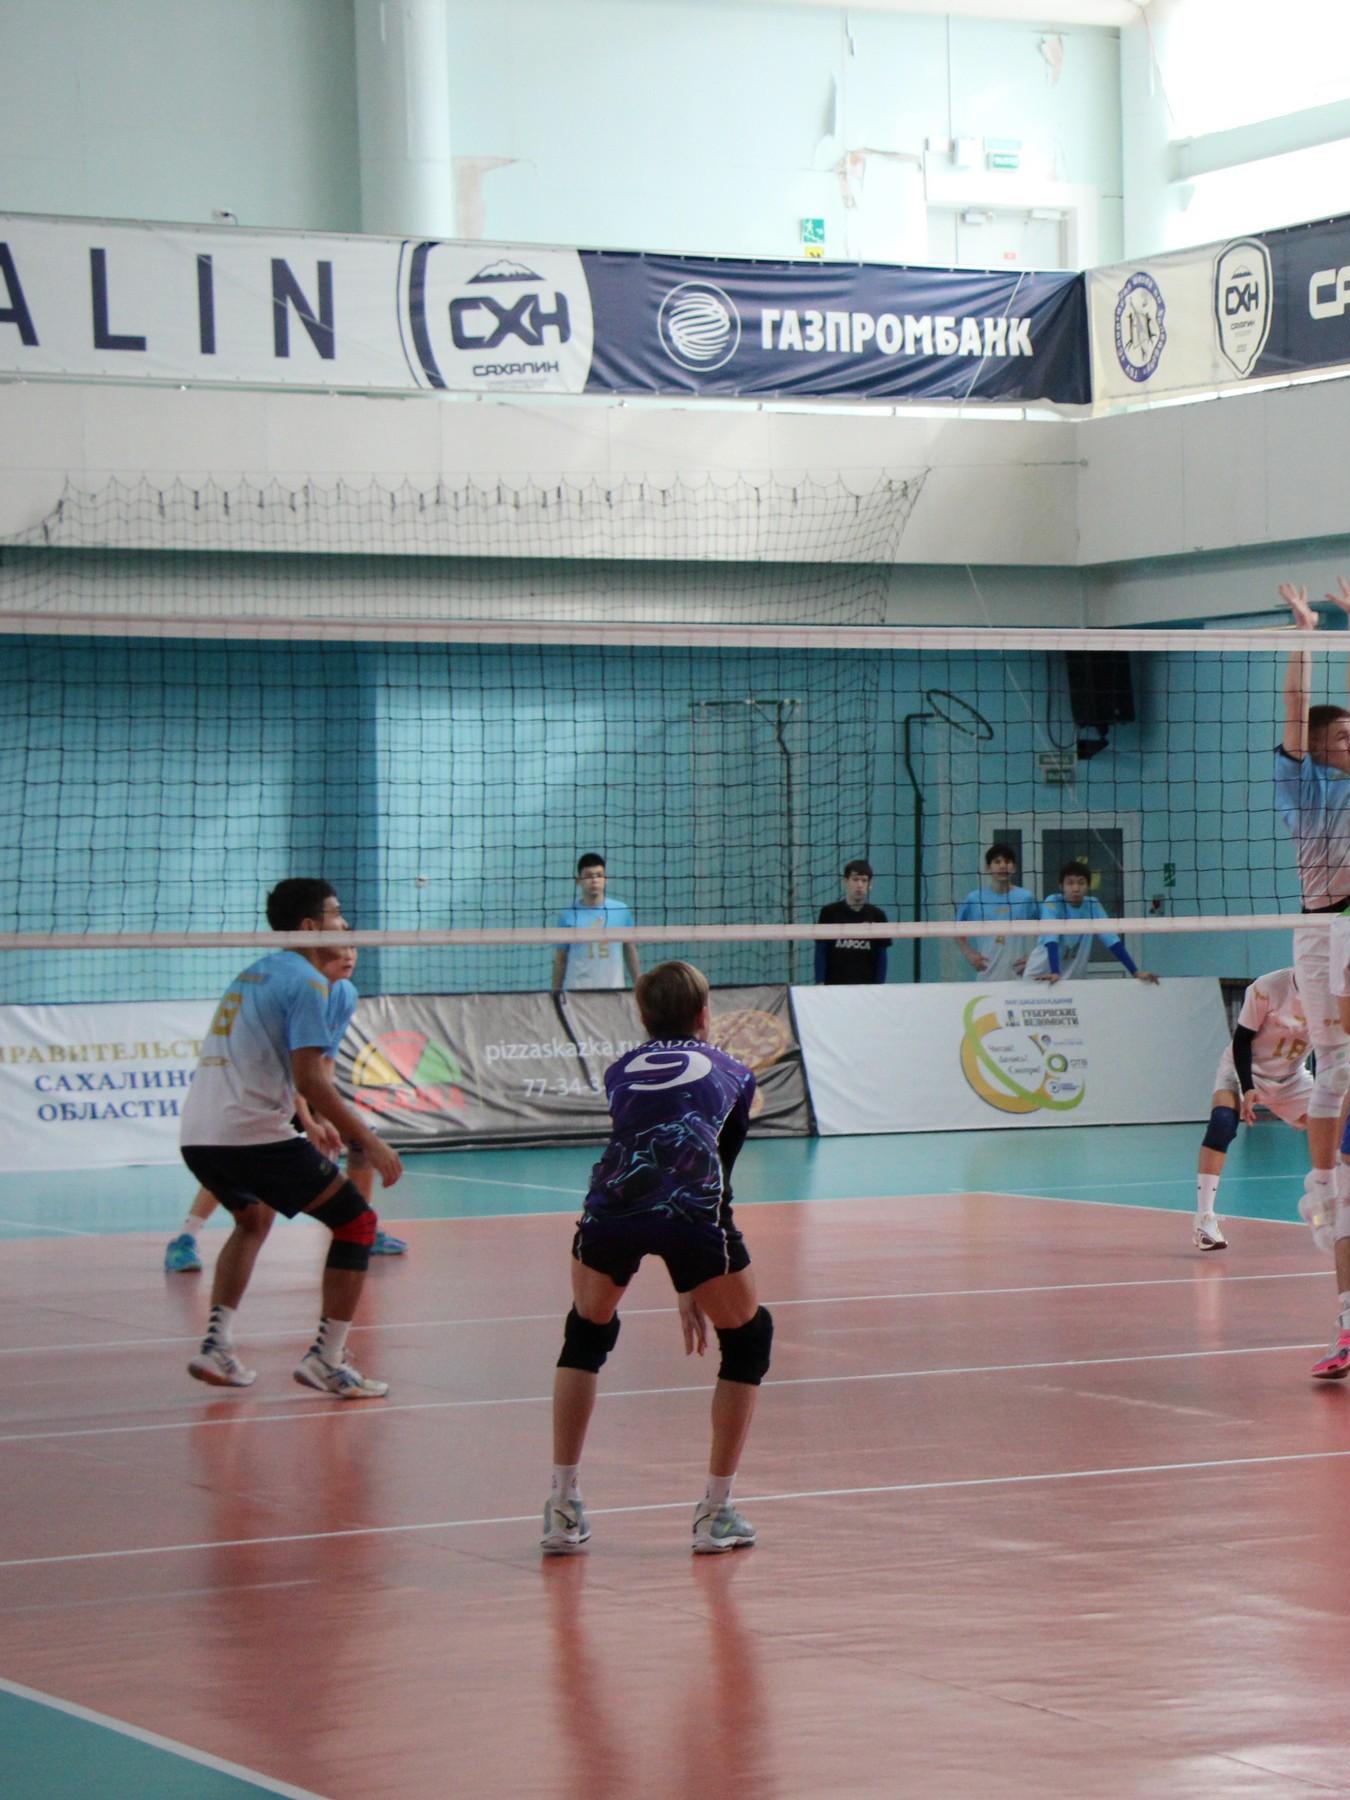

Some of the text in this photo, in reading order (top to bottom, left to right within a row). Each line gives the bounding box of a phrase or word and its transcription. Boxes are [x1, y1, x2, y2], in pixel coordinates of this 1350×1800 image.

[449, 291, 571, 350] СХН
[761, 309, 1034, 357] ГАЗПРОМБАНК
[472, 361, 559, 377] САХАЛИН
[0, 1039, 203, 1064] РАВИТЕЛЬСТ
[35, 1069, 195, 1092] САХАЛИН
[624, 1050, 712, 1091] 9
[37, 1099, 180, 1122] ОБЛАСТИ
